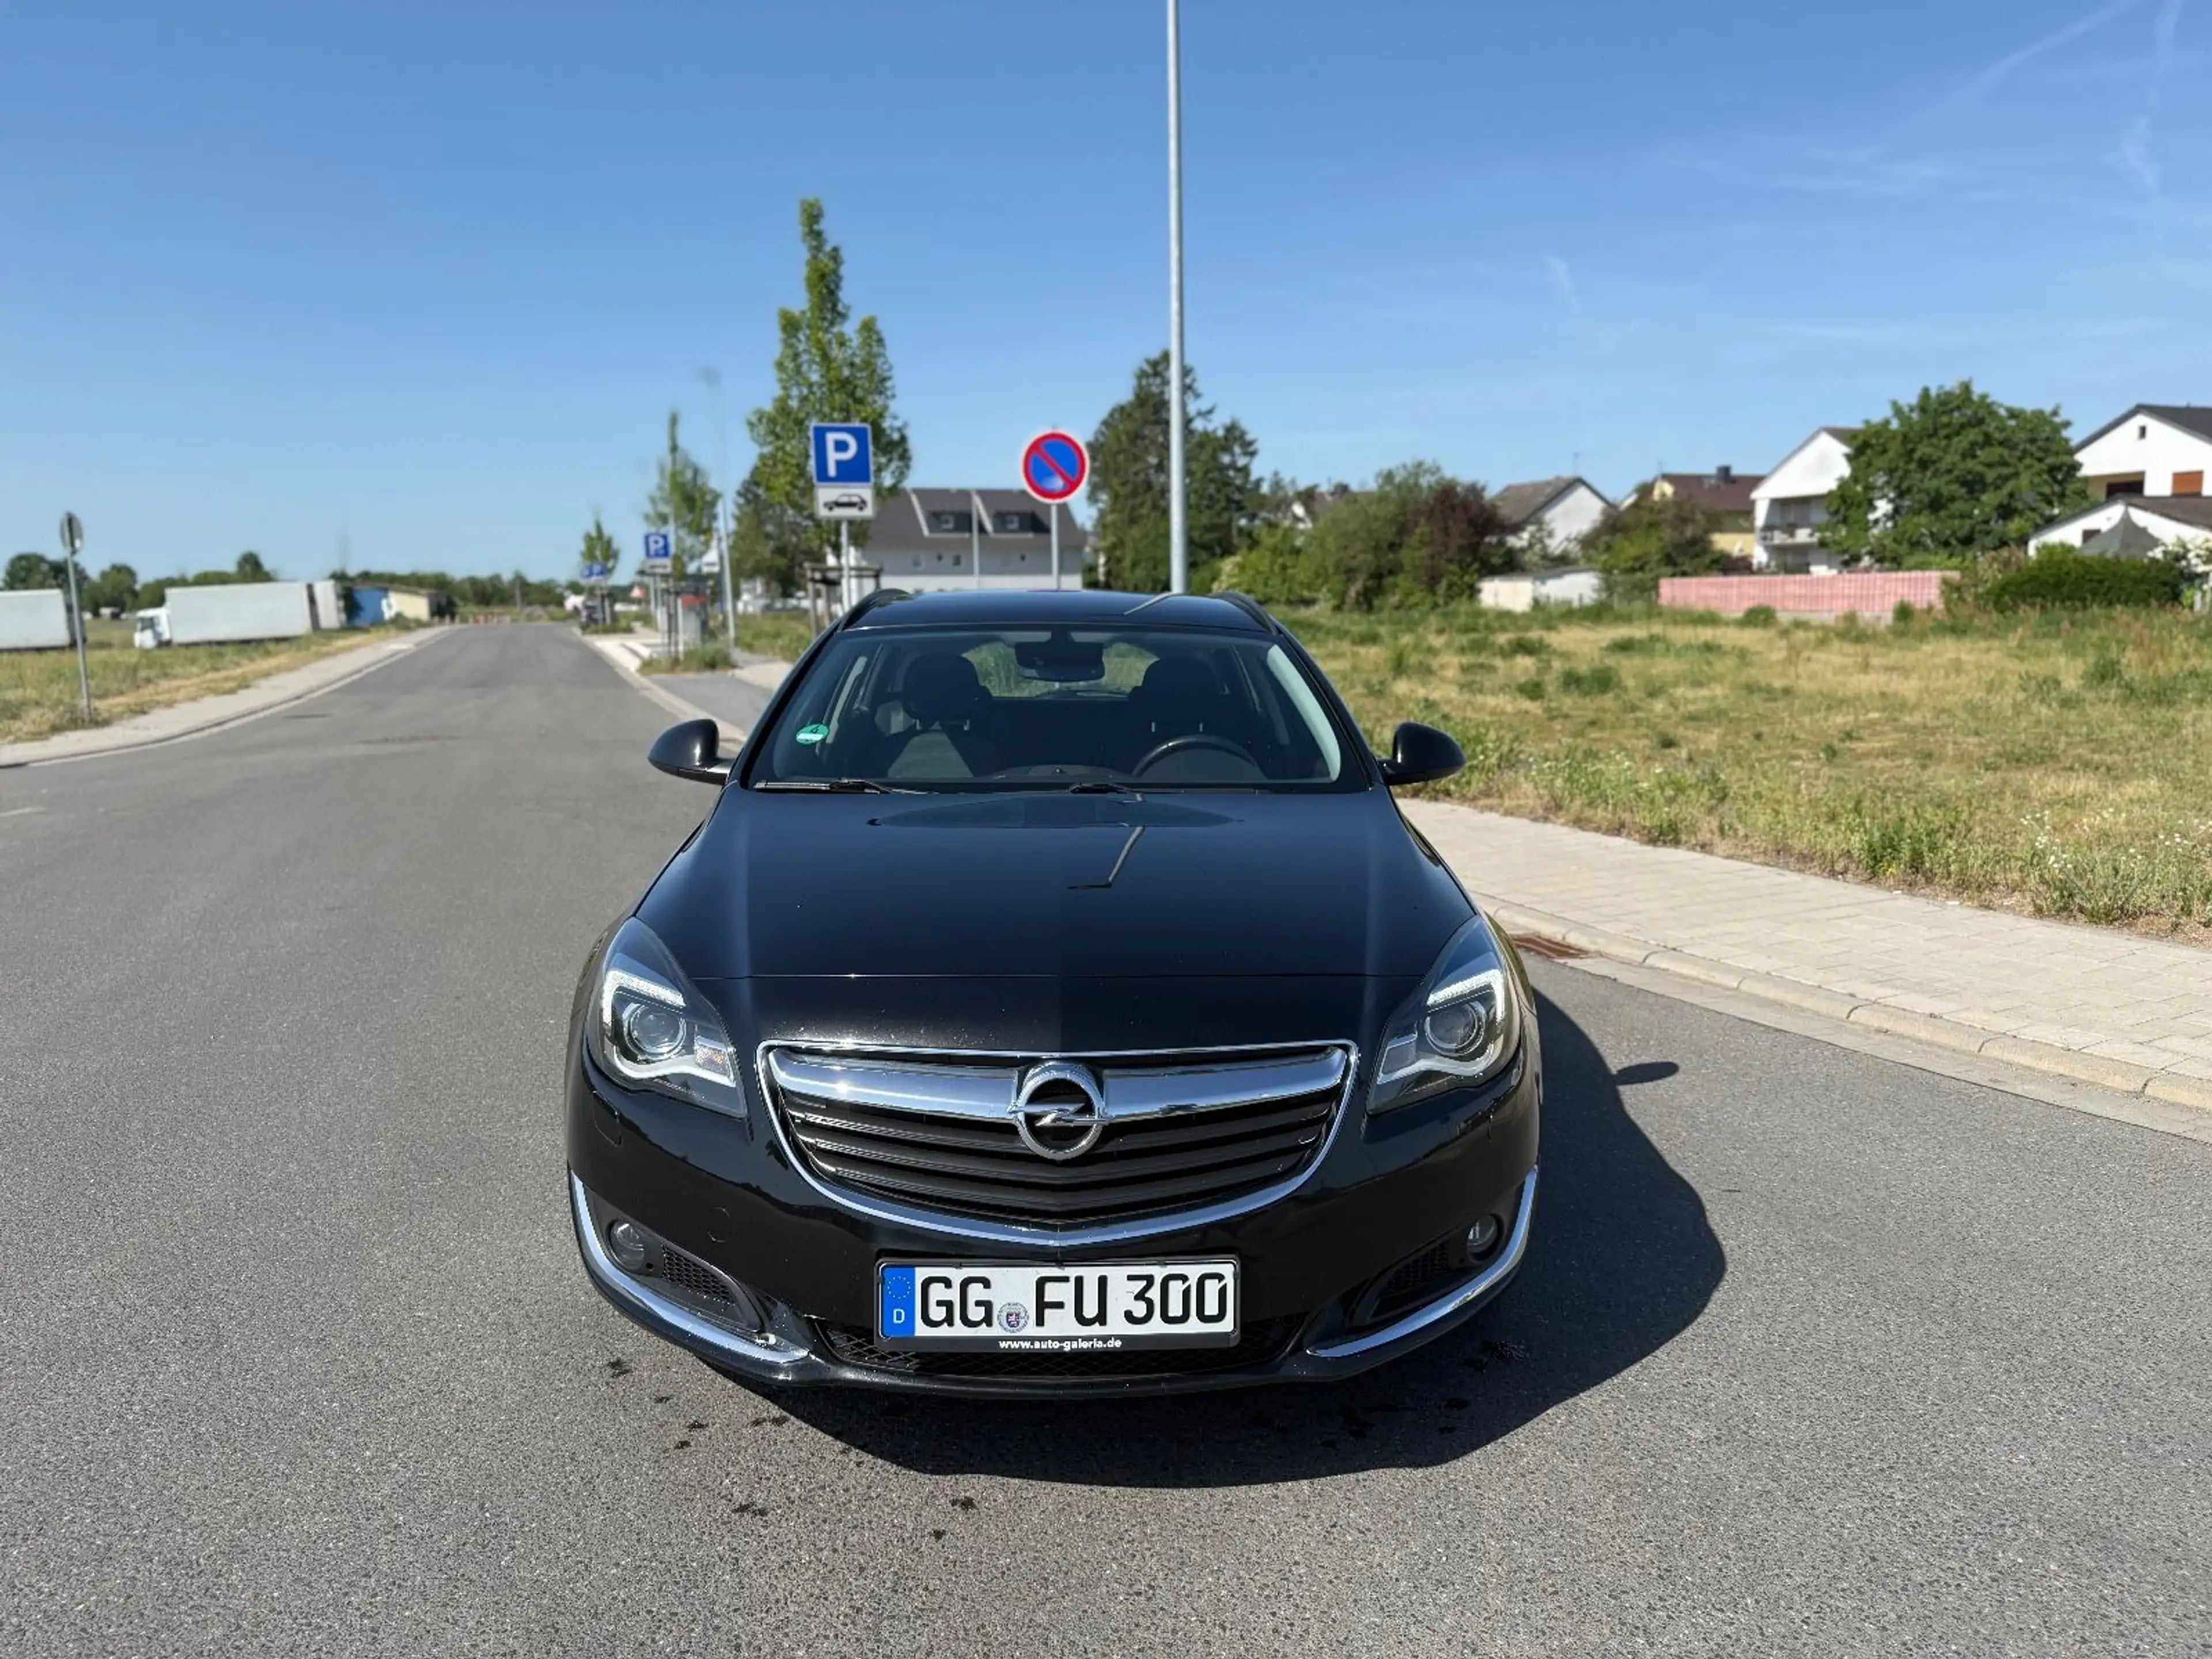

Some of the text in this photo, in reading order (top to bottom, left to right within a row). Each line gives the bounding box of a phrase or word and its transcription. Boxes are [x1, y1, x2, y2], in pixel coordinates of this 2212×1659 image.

[825, 432, 857, 478] P
[649, 536, 664, 556] P
[921, 1276, 994, 1328] GG
[1036, 1275, 1107, 1327] FU
[1124, 1272, 1227, 1325] 300
[893, 1309, 905, 1324] D
[998, 1336, 1122, 1352] www.auto-galeria.de
